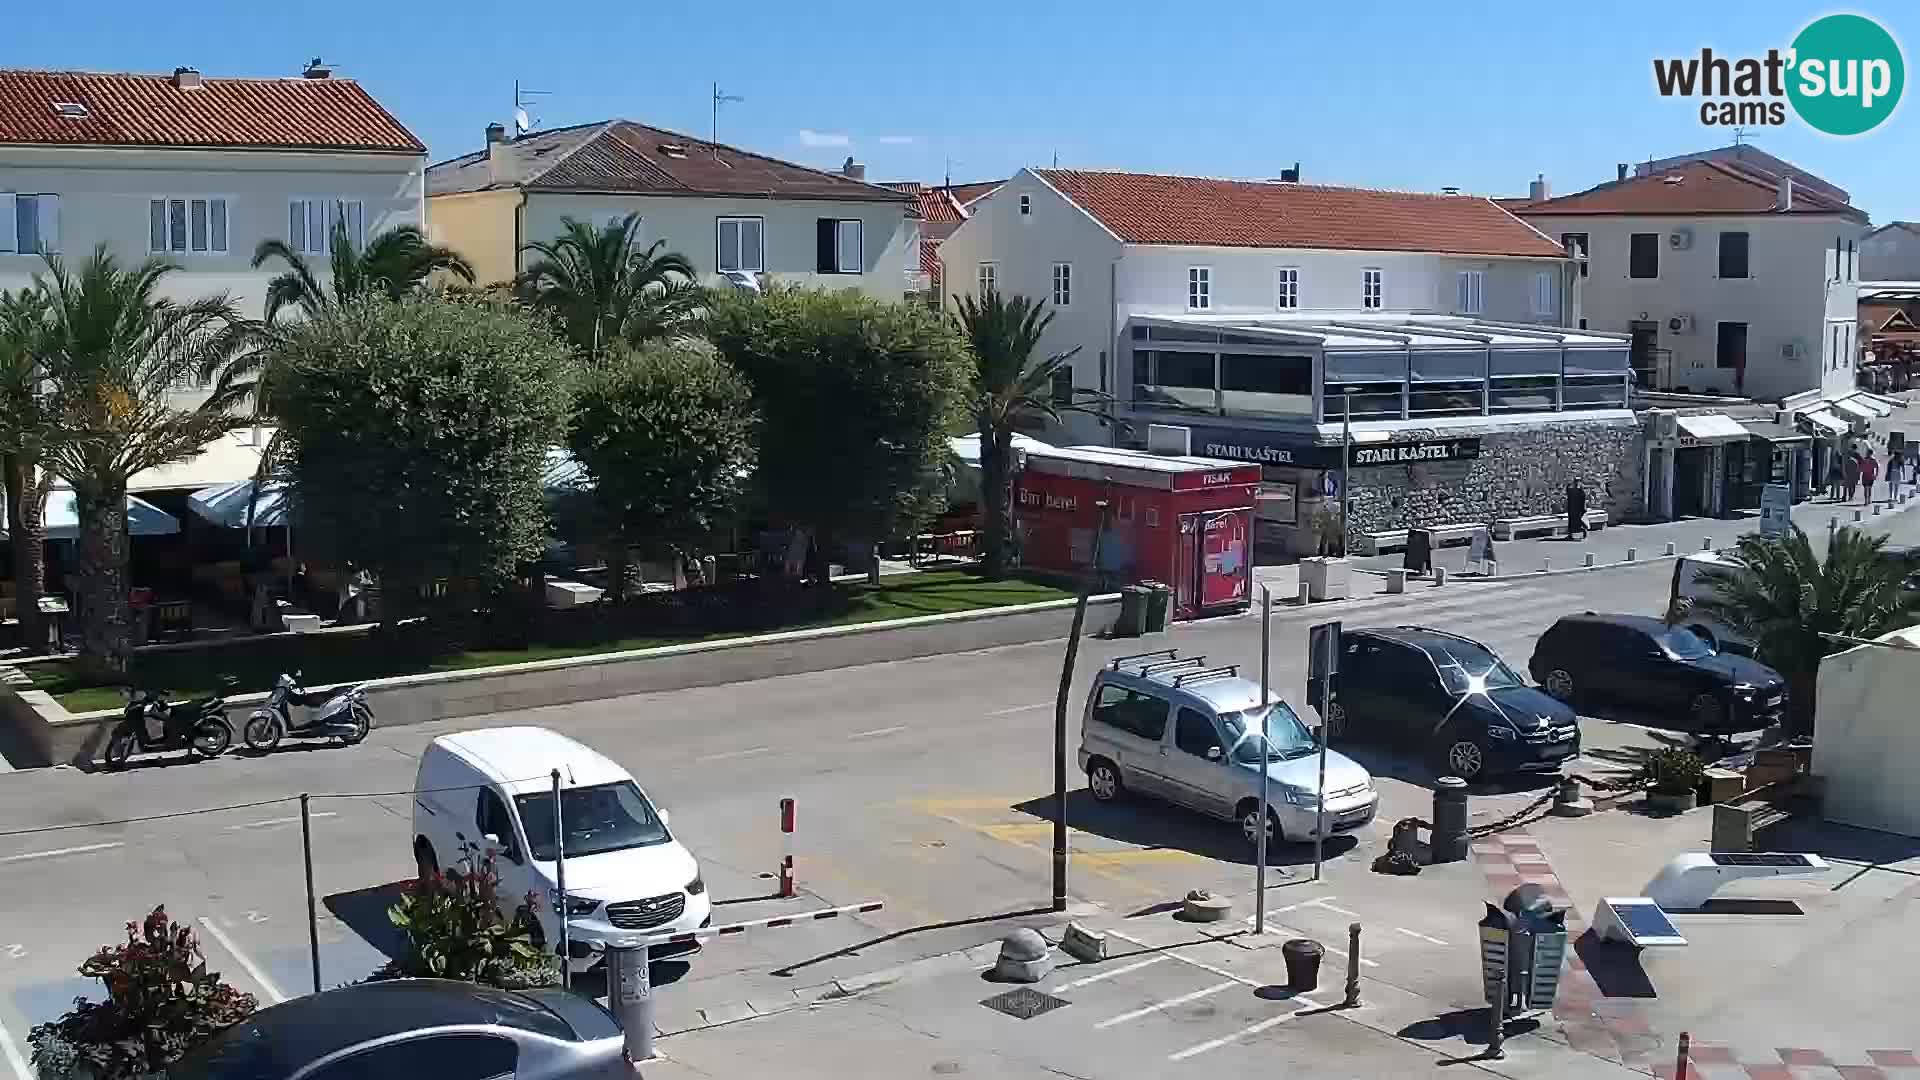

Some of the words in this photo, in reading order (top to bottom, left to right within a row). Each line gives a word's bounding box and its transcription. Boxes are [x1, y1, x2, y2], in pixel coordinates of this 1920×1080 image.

[1206, 443, 1241, 458] STARI
[1356, 448, 1396, 463] STARI
[1398, 443, 1449, 461] KAŠTEL
